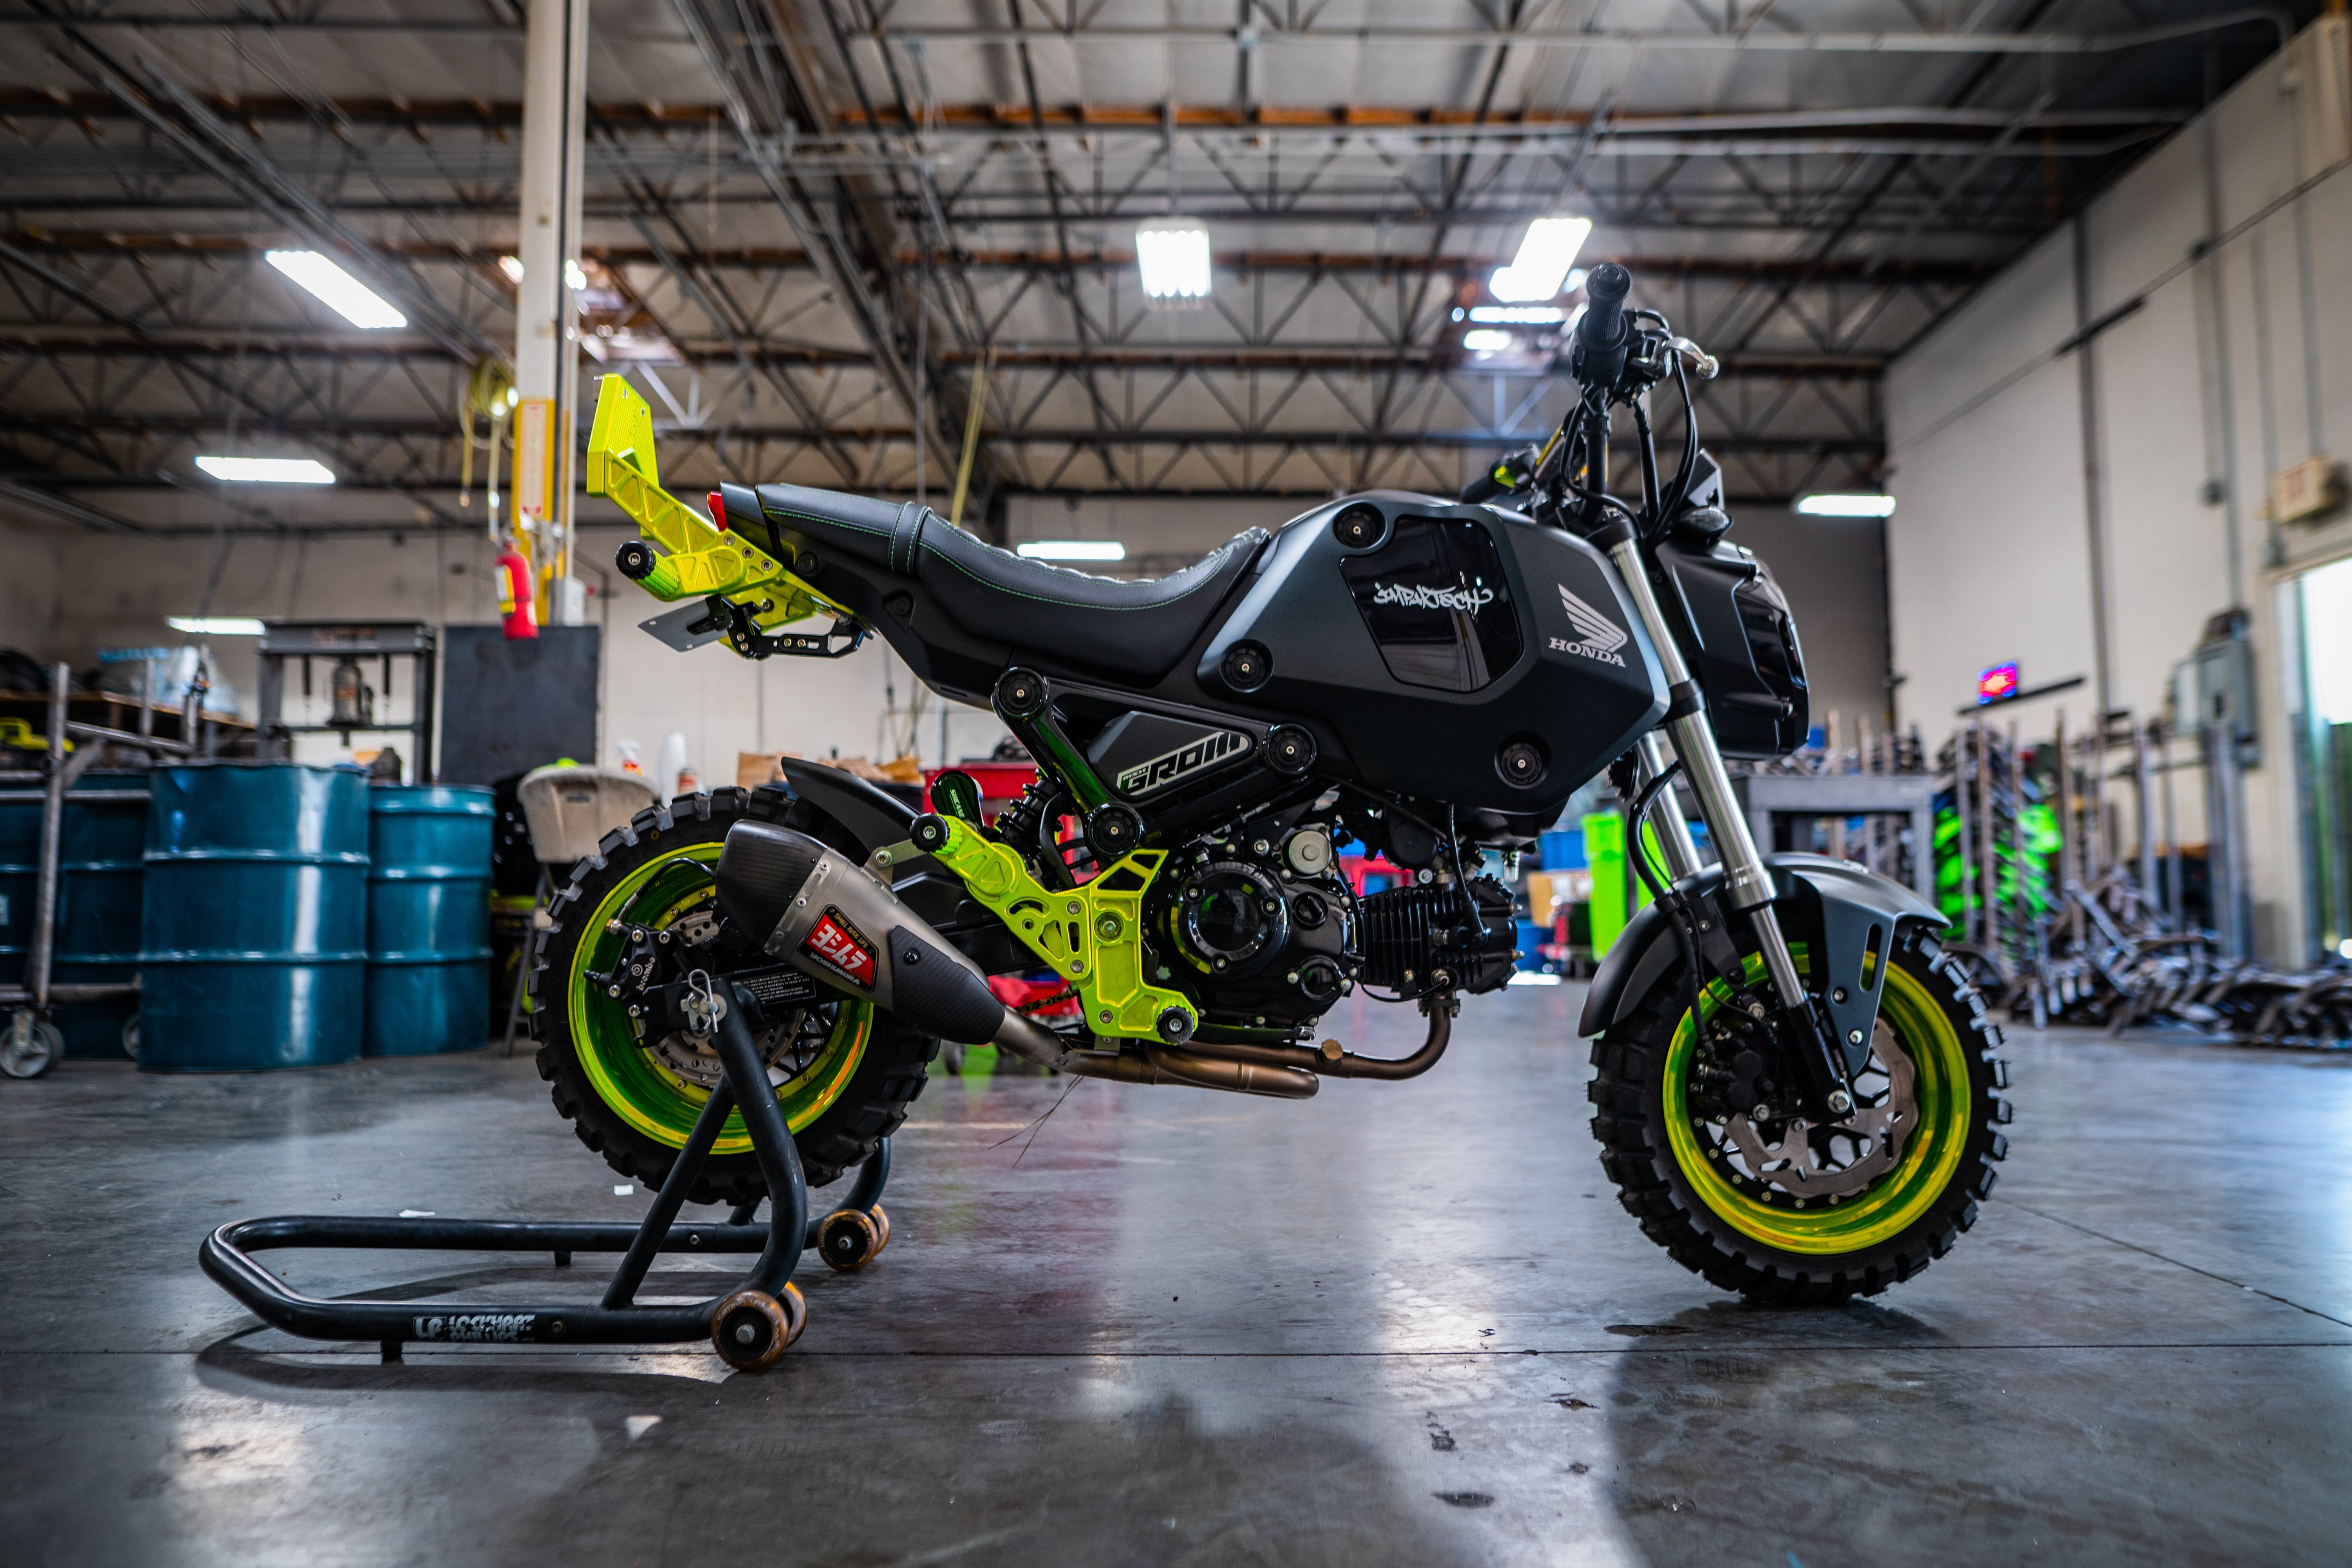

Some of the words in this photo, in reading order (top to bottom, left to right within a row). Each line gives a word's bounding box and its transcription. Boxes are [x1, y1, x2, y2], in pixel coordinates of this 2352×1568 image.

[1548, 637, 1626, 668] HONDA
[1120, 733, 1242, 794] GROM
[811, 924, 867, 969] ヨシムラ
[858, 937, 869, 949] LIFE
[636, 957, 656, 991] brembo
[809, 952, 860, 985] YOSHIMURA
[415, 1318, 443, 1339] LP
